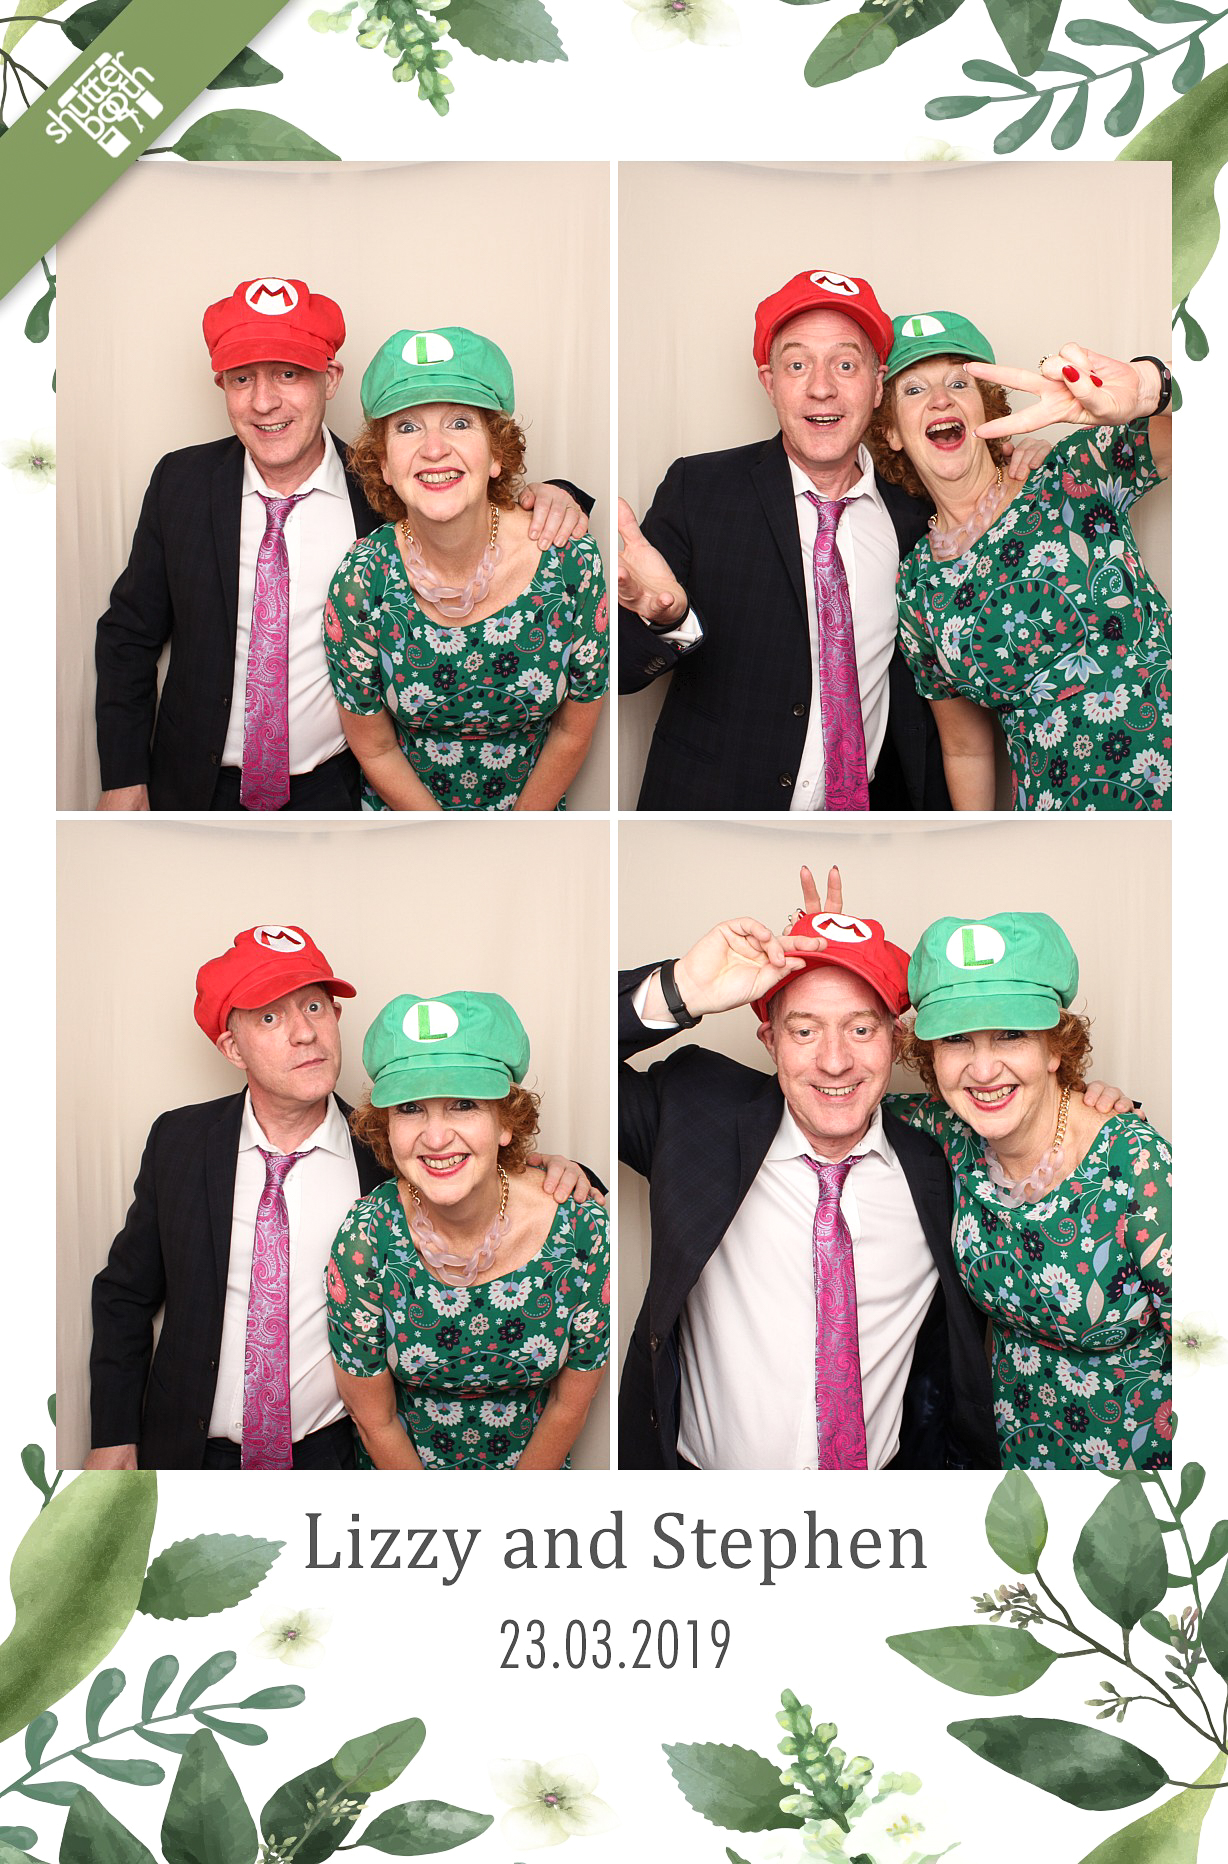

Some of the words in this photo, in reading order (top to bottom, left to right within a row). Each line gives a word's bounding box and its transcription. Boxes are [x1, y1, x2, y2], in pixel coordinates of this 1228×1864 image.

[250, 284, 294, 307] M
[416, 336, 445, 364] L
[961, 928, 995, 967] L
[418, 1005, 448, 1041] L
